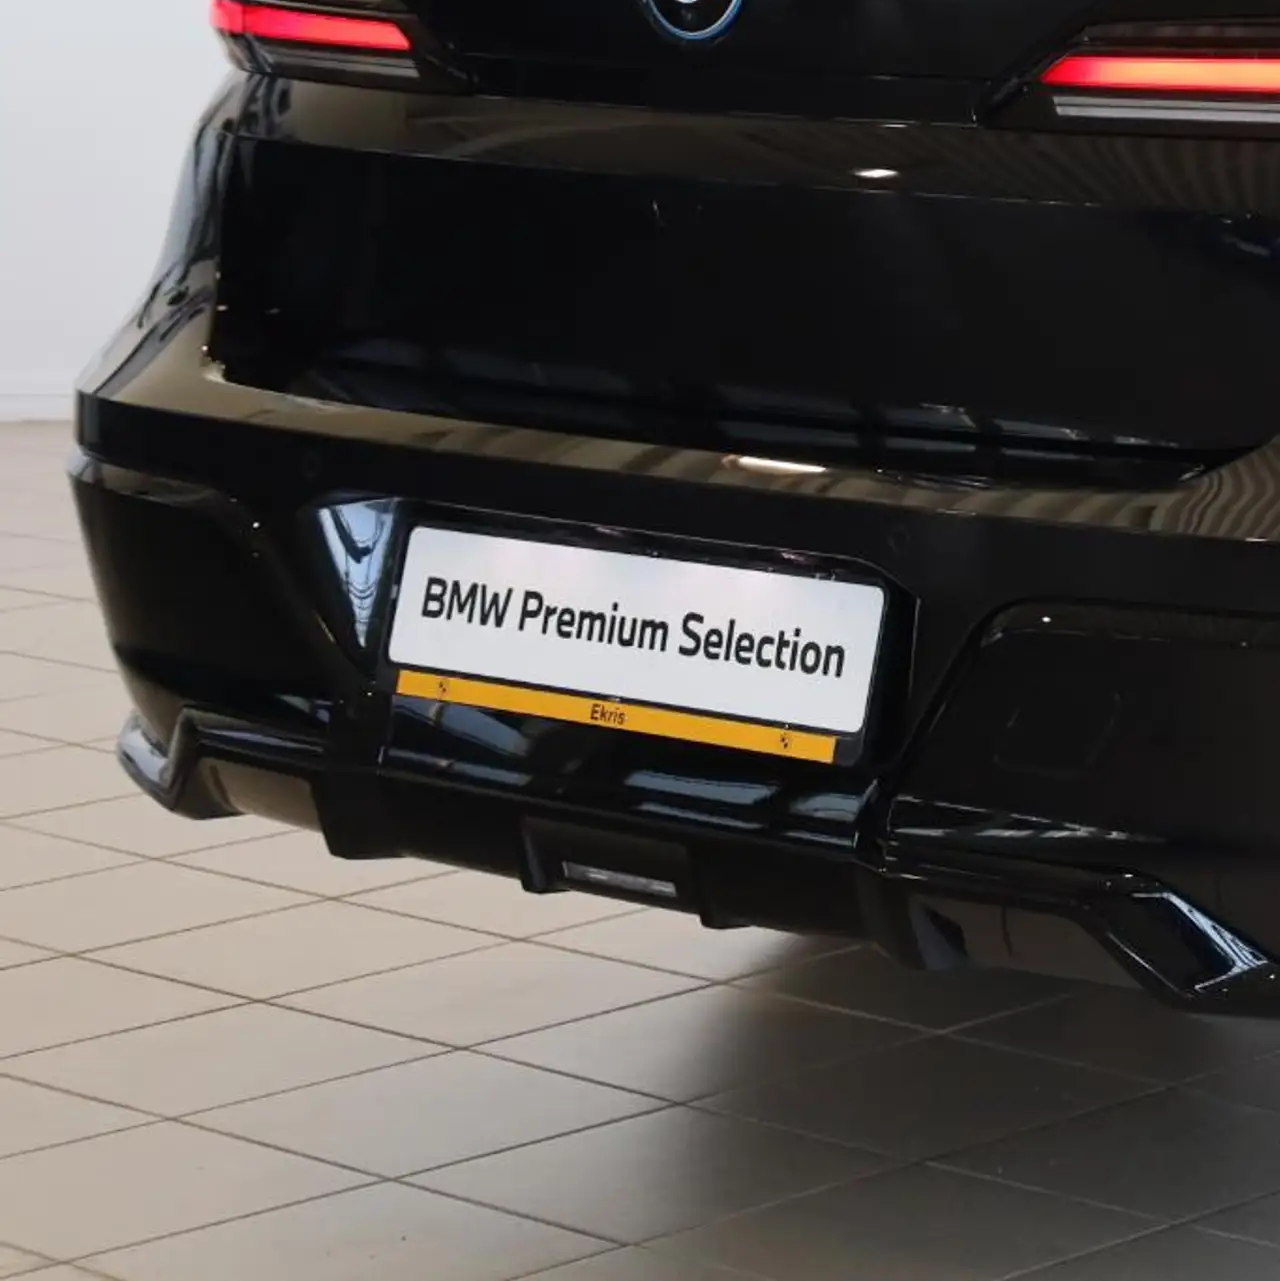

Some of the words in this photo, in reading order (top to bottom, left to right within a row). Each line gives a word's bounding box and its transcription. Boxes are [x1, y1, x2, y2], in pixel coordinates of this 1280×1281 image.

[420, 576, 514, 628] BMW
[517, 589, 669, 653] Premium
[677, 611, 847, 679] Selection
[590, 703, 627, 726] Ekris
